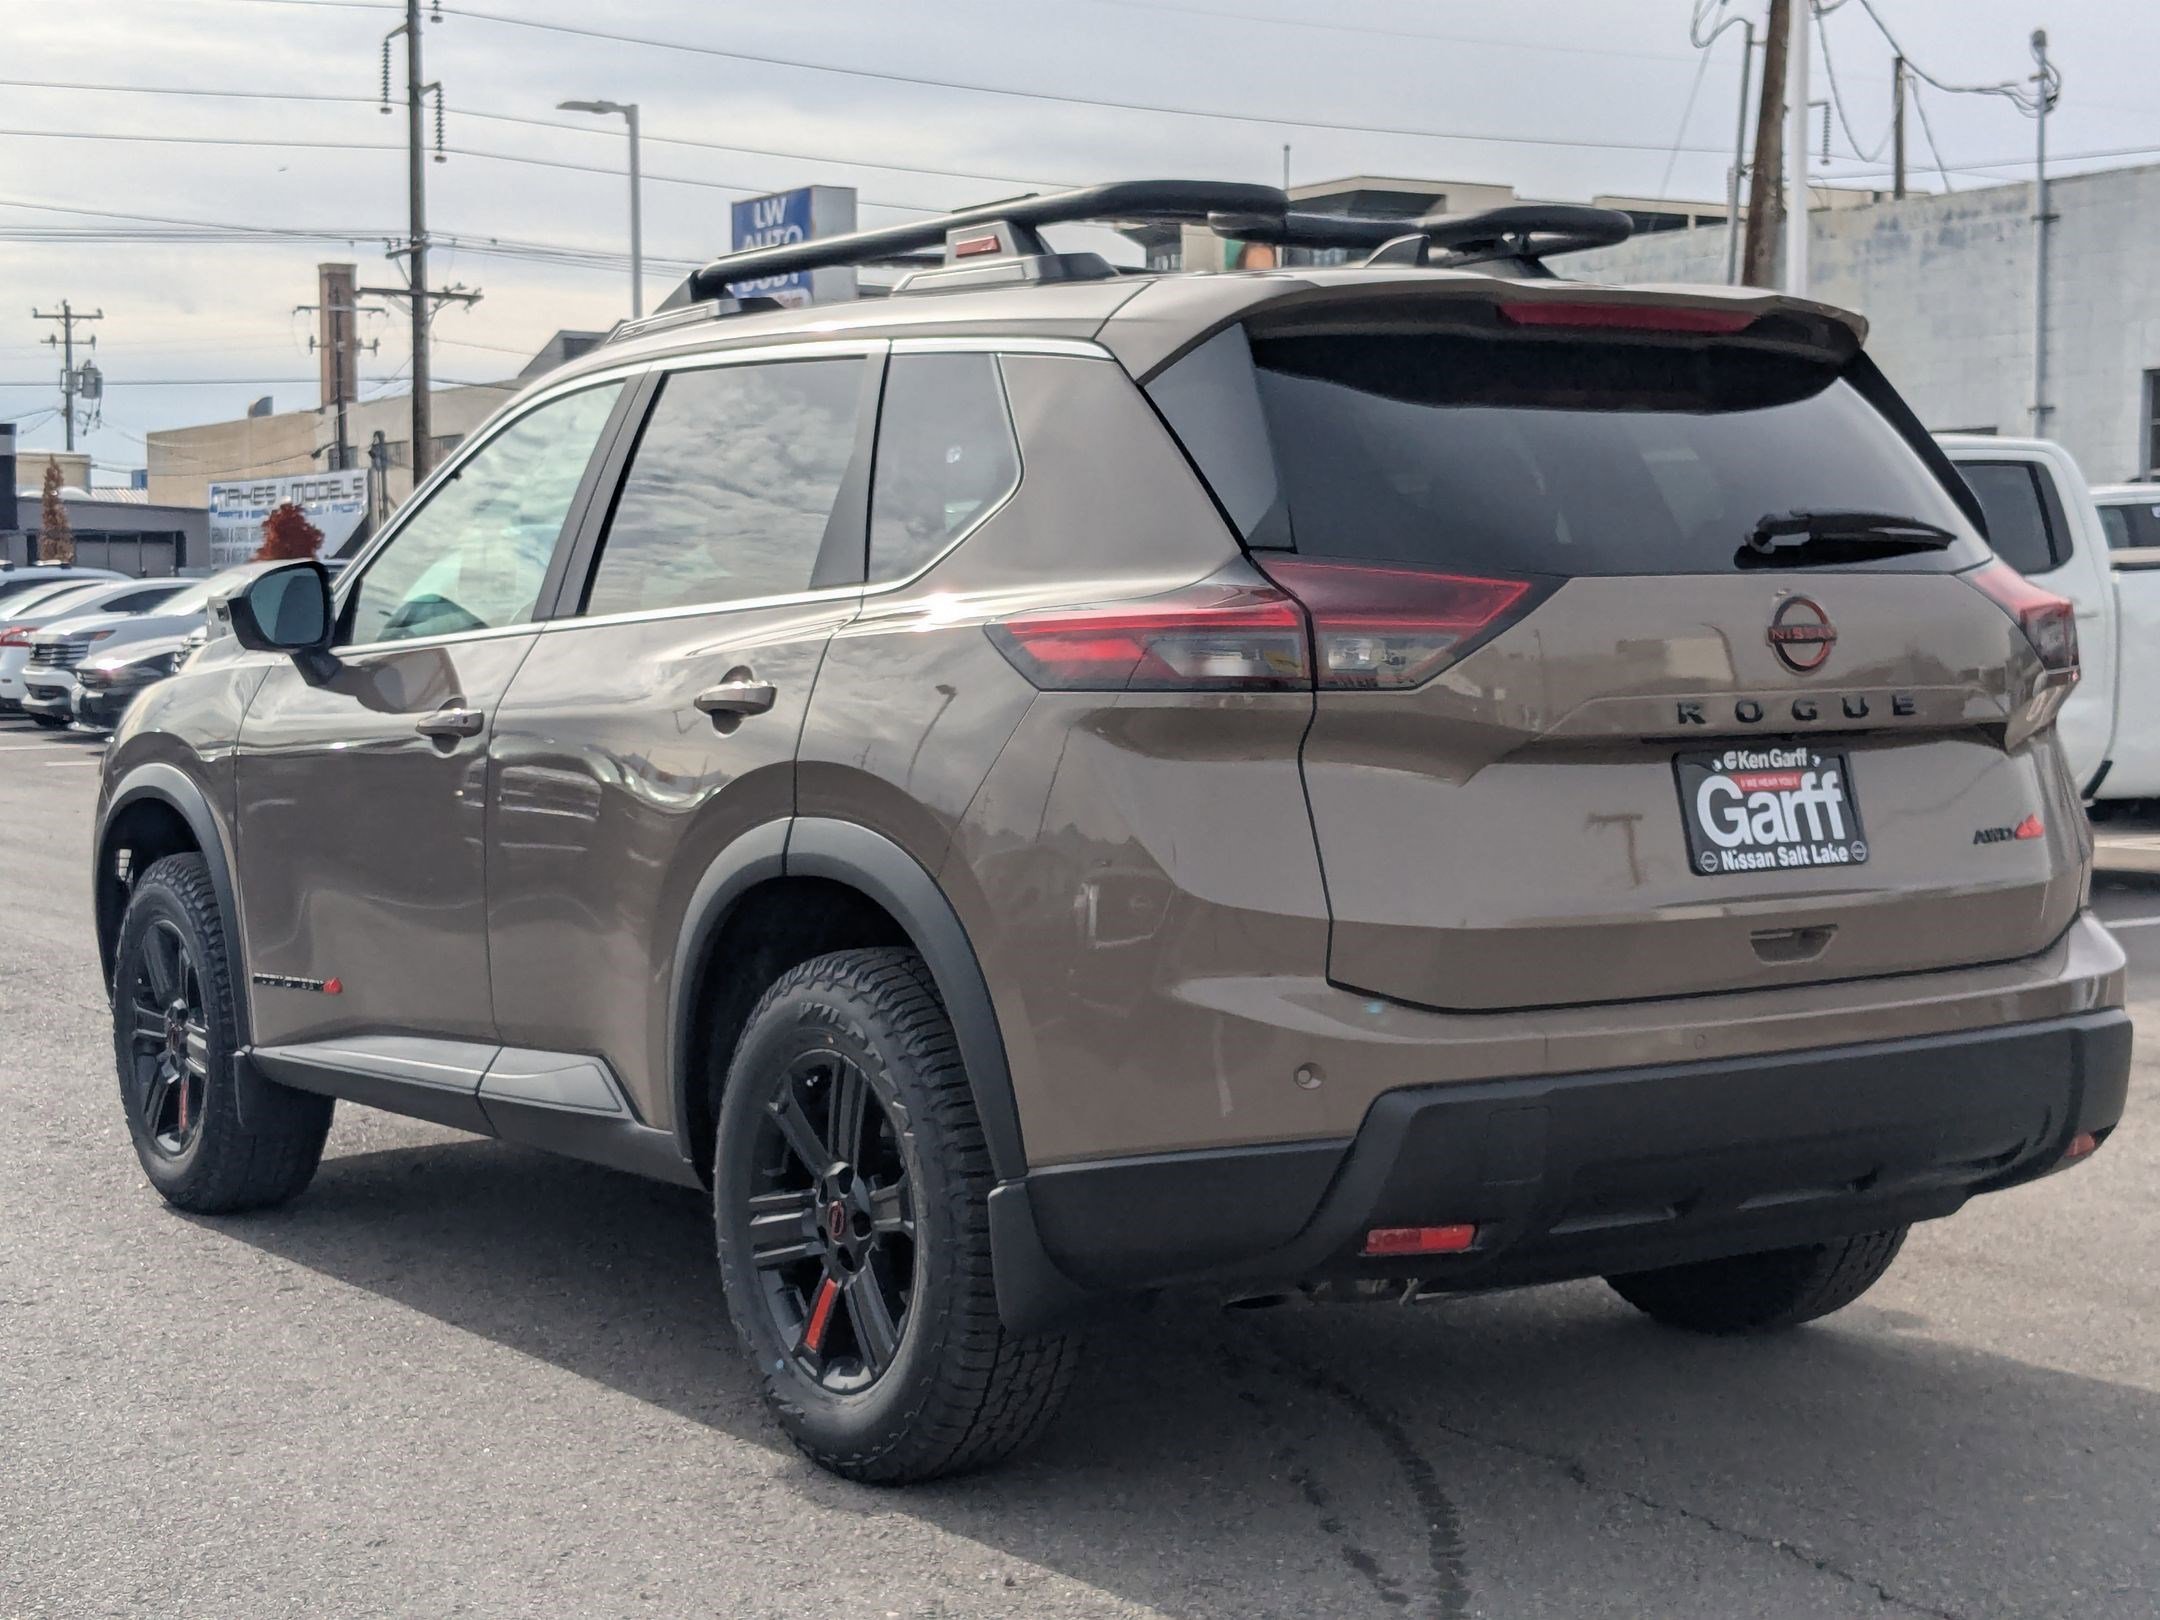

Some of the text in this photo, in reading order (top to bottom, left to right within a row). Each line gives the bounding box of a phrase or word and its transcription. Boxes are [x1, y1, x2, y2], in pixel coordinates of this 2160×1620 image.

[753, 197, 787, 229] LW
[292, 476, 363, 503] MODELS
[1677, 696, 1917, 725] ROGUE
[1697, 770, 1846, 849] Garff
[1720, 850, 1776, 872] Nissan
[1776, 845, 1811, 868] Salt
[1811, 843, 1849, 864] Lake
